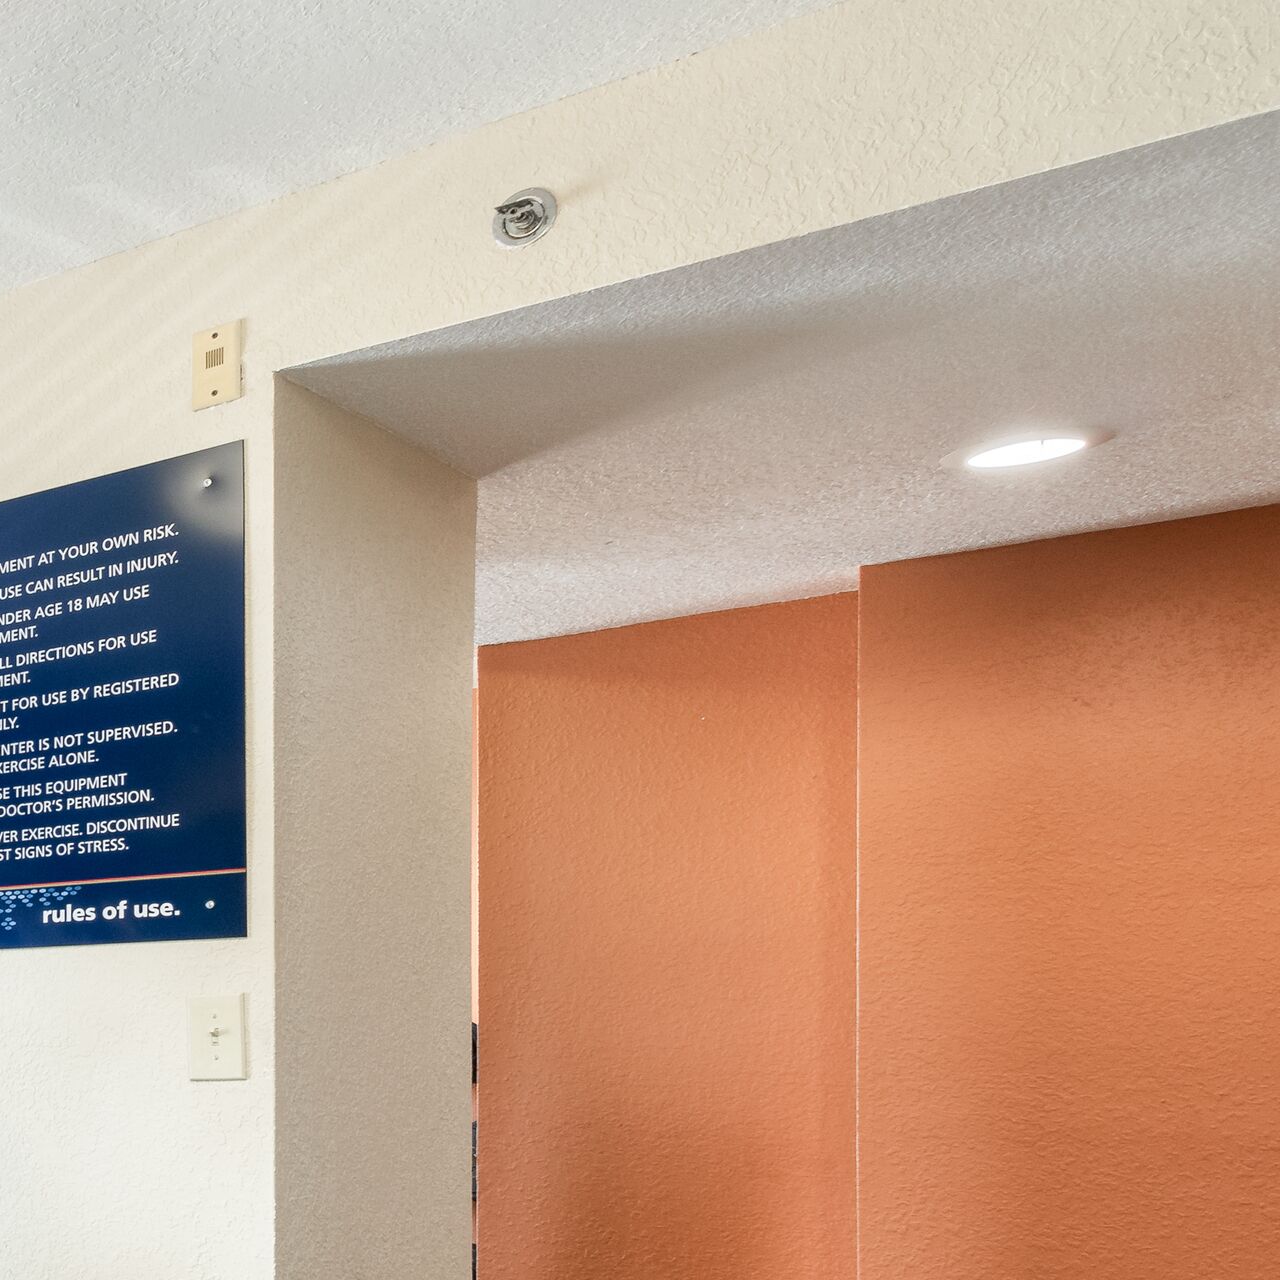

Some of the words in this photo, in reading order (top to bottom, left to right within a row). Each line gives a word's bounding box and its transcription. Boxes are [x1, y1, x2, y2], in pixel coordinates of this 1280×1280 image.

[38, 550, 56, 566] AT
[58, 541, 98, 560] YOUR
[102, 531, 139, 551] OWN
[144, 523, 179, 542] RISK.
[0, 584, 22, 600] USE
[25, 577, 53, 594] CAN
[57, 566, 105, 588] RESULT
[108, 563, 123, 577] IN
[127, 551, 179, 574] INJURY.
[34, 602, 62, 619] AGE
[67, 598, 83, 612] 18
[86, 590, 119, 609] MAY
[123, 584, 150, 601] USE
[16, 641, 94, 666] DIRECTIONS
[98, 636, 126, 652] FOR
[130, 629, 157, 646] USE
[12, 696, 38, 711] FOR
[42, 691, 67, 706] USE
[71, 687, 90, 702] BY
[94, 673, 179, 698] REGISTERED
[39, 738, 50, 751] IS
[54, 733, 84, 749] NOT
[87, 721, 178, 744] SUPERVISED.
[48, 750, 99, 768] ALONE.
[13, 783, 42, 798] THIS
[46, 773, 127, 794] EQUIPMENT
[67, 789, 154, 810] PERMISSION.
[21, 824, 83, 841] EXERCISE.
[86, 813, 180, 835] DISCONTINUE
[15, 845, 52, 860] SIGNS
[56, 842, 74, 856] OF
[78, 838, 129, 854] STRESS.
[43, 904, 96, 923] rules
[102, 900, 127, 920] of
[134, 902, 180, 918] use.
